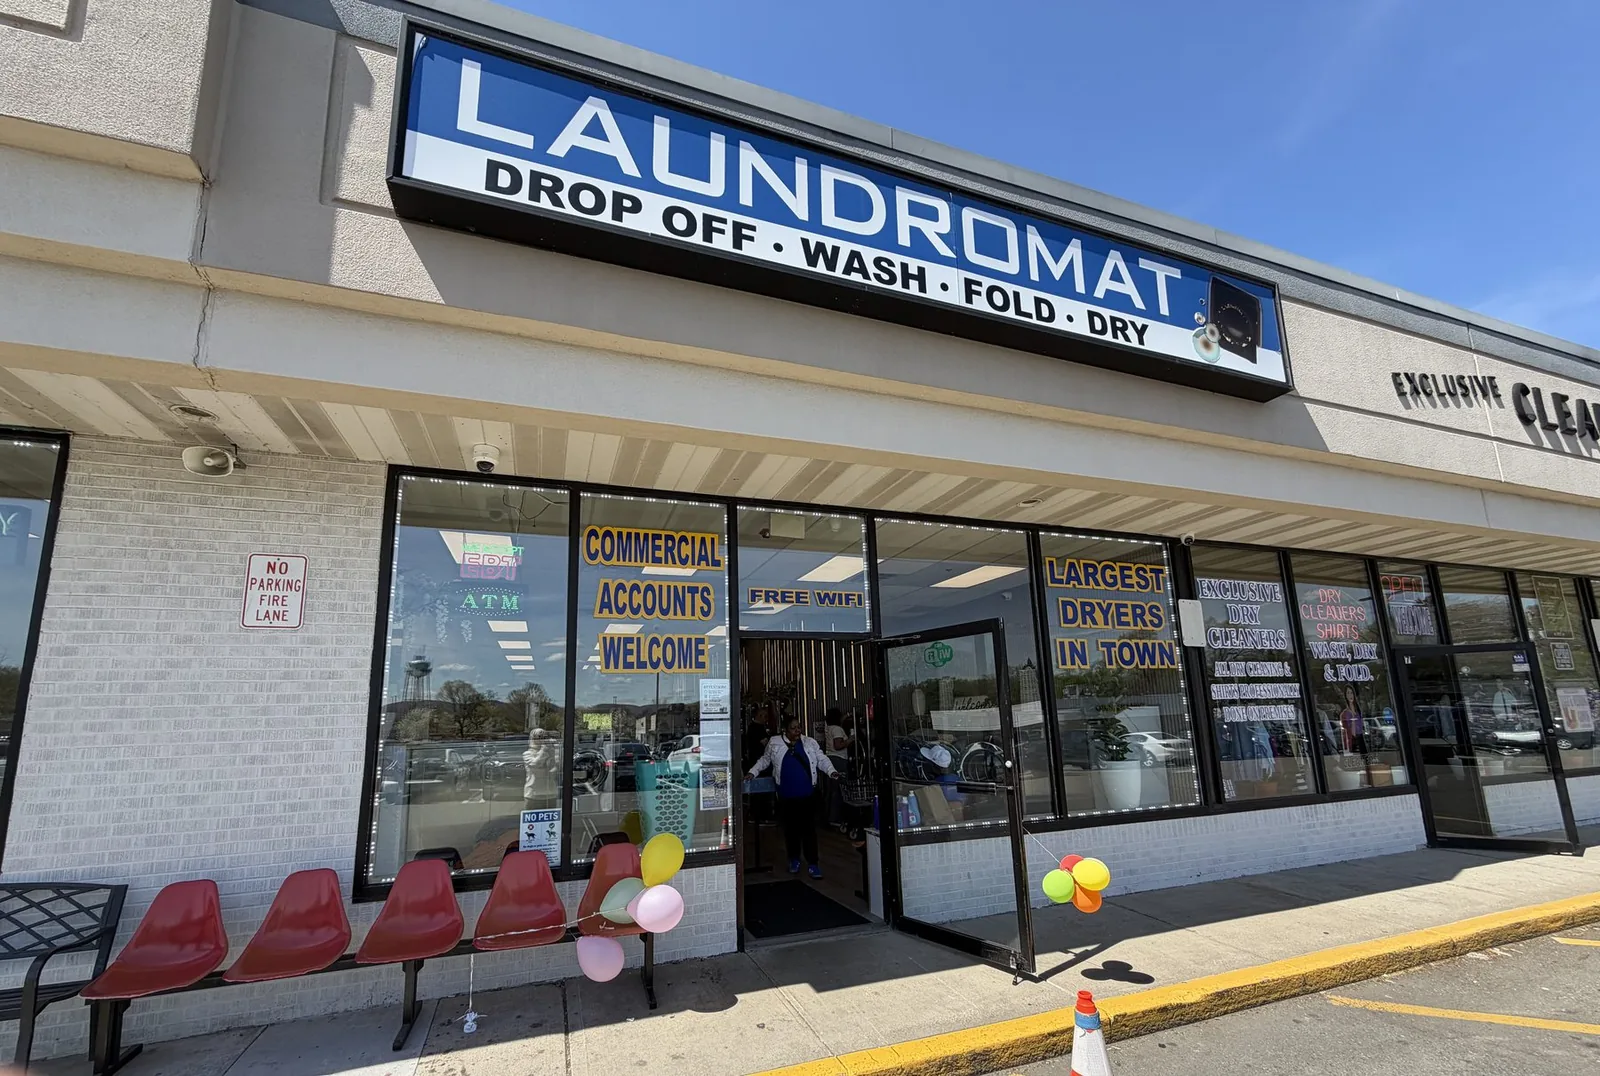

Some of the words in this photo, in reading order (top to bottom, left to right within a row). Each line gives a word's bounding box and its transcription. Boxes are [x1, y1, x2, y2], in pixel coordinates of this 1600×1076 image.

[456, 58, 1182, 317] LAUNDROMAT
[484, 158, 643, 223] DROP
[662, 205, 757, 251] OFF
[799, 237, 928, 294] WASH
[964, 276, 1056, 324] FOLD
[1086, 308, 1149, 347] DRY
[1391, 371, 1502, 399] EXCLUSIVE
[584, 527, 722, 568] COMMERCIAL
[266, 561, 289, 575] NO
[460, 553, 523, 581] EBT
[1046, 558, 1166, 592] LARGEST
[249, 577, 302, 593] PARKING
[1197, 578, 1282, 602] EXCLUSIVE
[1381, 575, 1425, 601] OPEN
[259, 594, 289, 607] FIRE
[460, 593, 520, 610] ATM
[597, 581, 713, 618] ACCOUNTS
[749, 588, 809, 605] FREE
[815, 590, 864, 608] WIFI
[1318, 588, 1341, 604] DRY
[255, 609, 289, 622] LANE
[1061, 599, 1164, 630] DRYERS
[1226, 603, 1261, 625] DRY
[1301, 603, 1366, 621] CLEANERS
[1391, 606, 1434, 635] WELCOME
[1207, 627, 1287, 650] CLEANERS
[1316, 623, 1360, 640] SHIRTS
[601, 636, 707, 670] WELCOME
[1057, 639, 1089, 669] IN
[1100, 639, 1176, 669] TOWN
[1309, 641, 1352, 662] WASH,
[1352, 642, 1378, 660] DRY
[1215, 661, 1230, 677] ALL
[1229, 661, 1247, 677] DRY
[1246, 661, 1284, 677] CLEANING
[1284, 661, 1293, 677] &
[1324, 664, 1337, 682] &
[1336, 664, 1374, 682] FOLD.
[1211, 683, 1239, 700] SHIRTS
[1239, 682, 1301, 699] PROFESSIONALLY
[1223, 706, 1247, 723] DONE
[1260, 704, 1296, 721] PREMISES
[524, 813, 537, 822] NO
[538, 811, 559, 821] PETS
